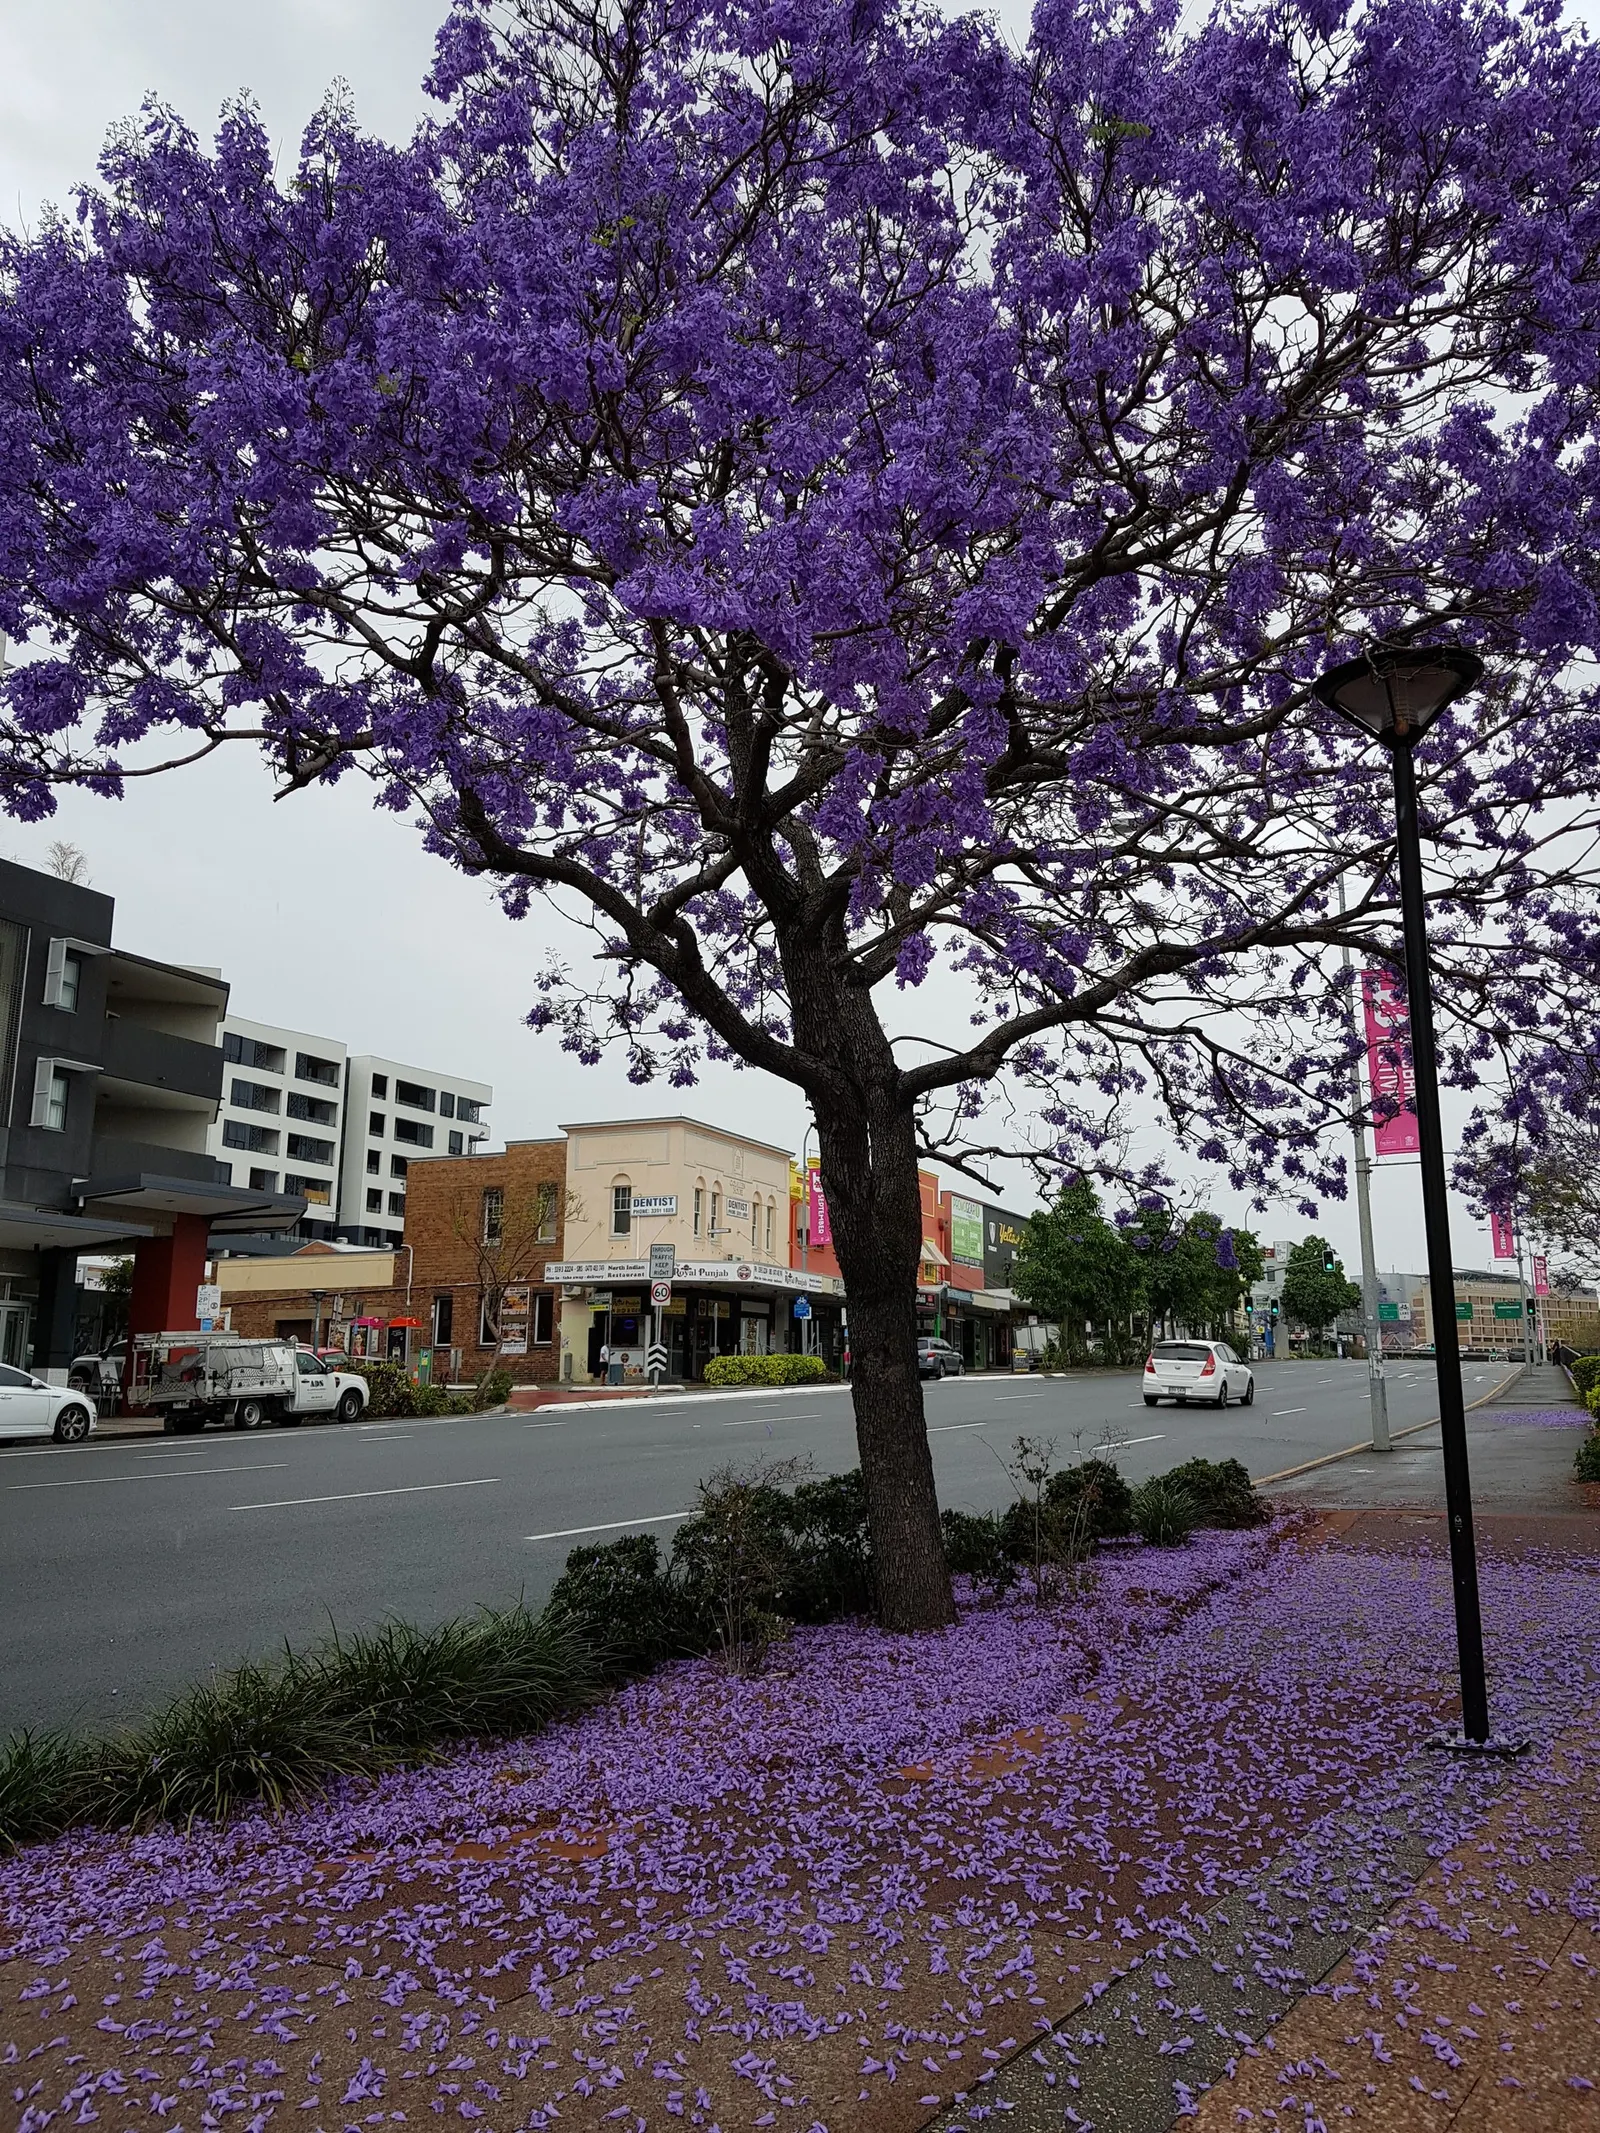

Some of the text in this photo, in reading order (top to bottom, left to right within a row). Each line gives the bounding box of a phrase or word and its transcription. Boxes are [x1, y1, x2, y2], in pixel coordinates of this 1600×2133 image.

[633, 1197, 674, 1207] DENTIST
[729, 1200, 748, 1212] DENTIST
[698, 1267, 729, 1278] Punjab
[654, 1287, 668, 1297] 60
[310, 1379, 324, 1387] ADS
